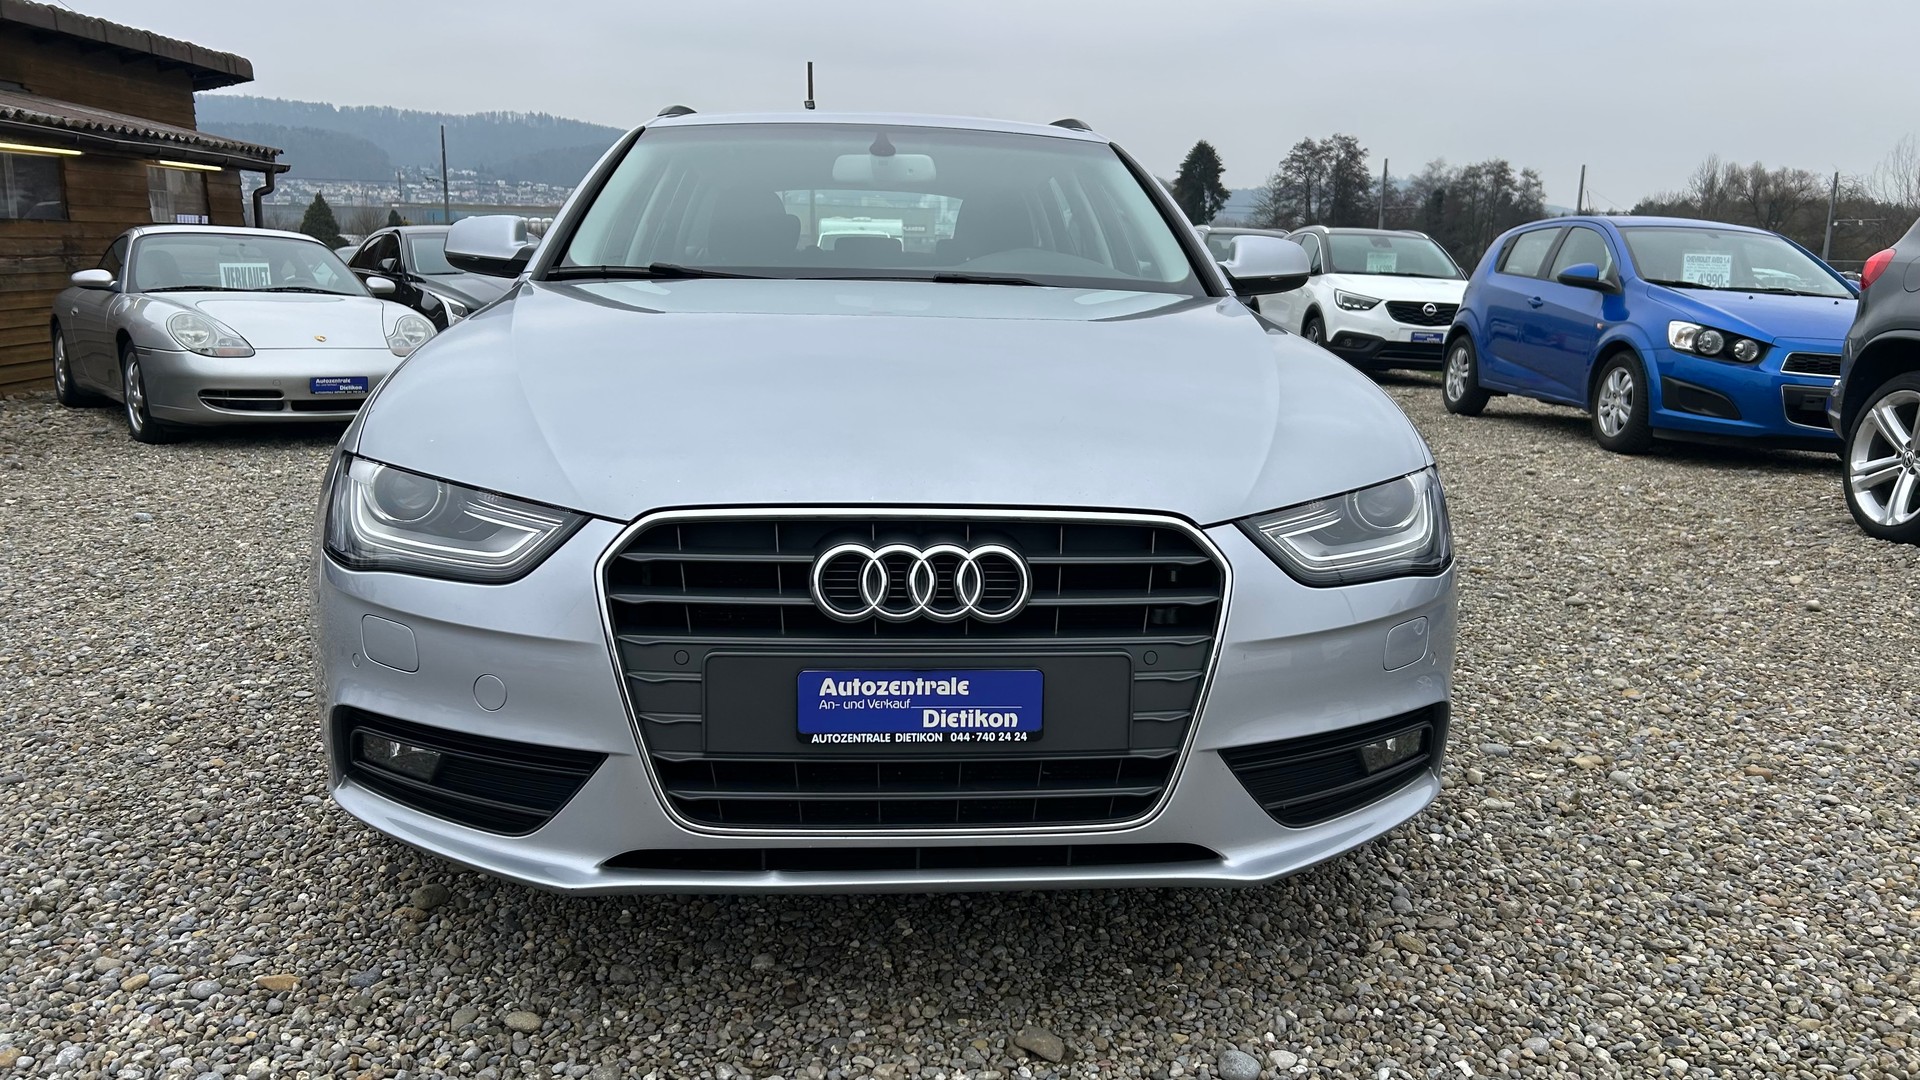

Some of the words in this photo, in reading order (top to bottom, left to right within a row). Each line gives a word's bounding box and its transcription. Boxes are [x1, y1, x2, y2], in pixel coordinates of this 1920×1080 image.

[223, 267, 269, 288] VERKAUFT
[819, 677, 970, 696] Autozentrale
[819, 699, 841, 709] An-
[843, 699, 865, 709] und
[867, 698, 911, 709] Verkauf
[922, 709, 1019, 728] Dietikon
[811, 733, 891, 744] AUTOZENTRALE
[895, 732, 943, 743] DIETIKON
[998, 732, 1012, 742] 24
[1014, 732, 1028, 742] 24
